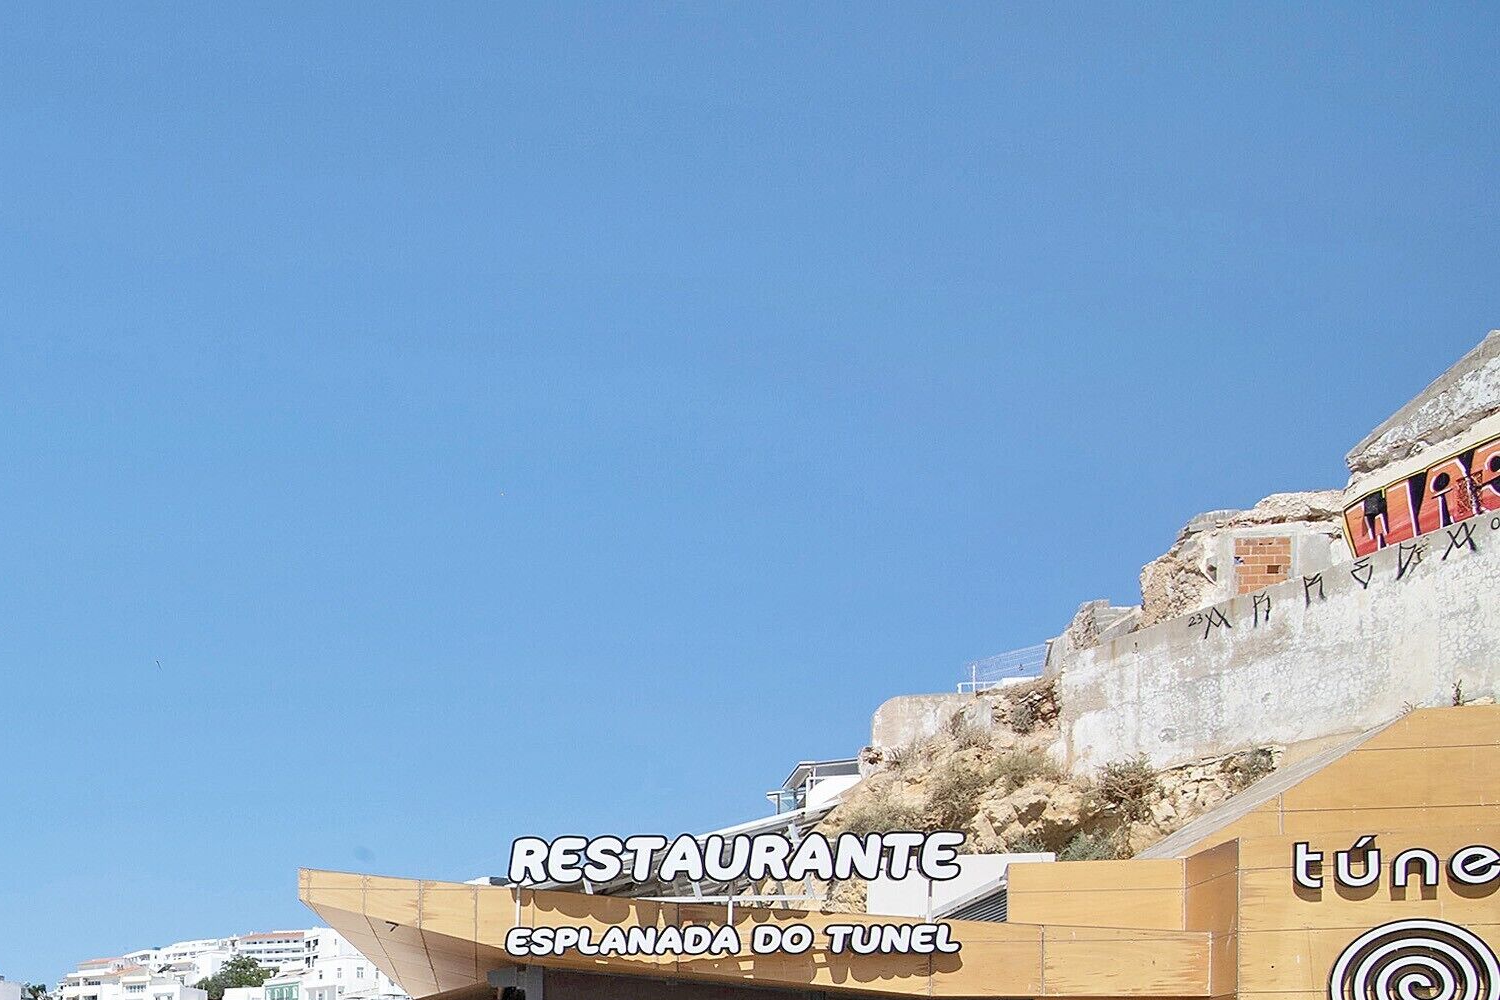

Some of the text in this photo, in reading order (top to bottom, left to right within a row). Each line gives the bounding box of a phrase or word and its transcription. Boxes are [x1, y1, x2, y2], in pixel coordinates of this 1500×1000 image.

[507, 831, 967, 884] RESTAURANTE
[505, 923, 963, 957] ESPLANADA DO TUNEL
